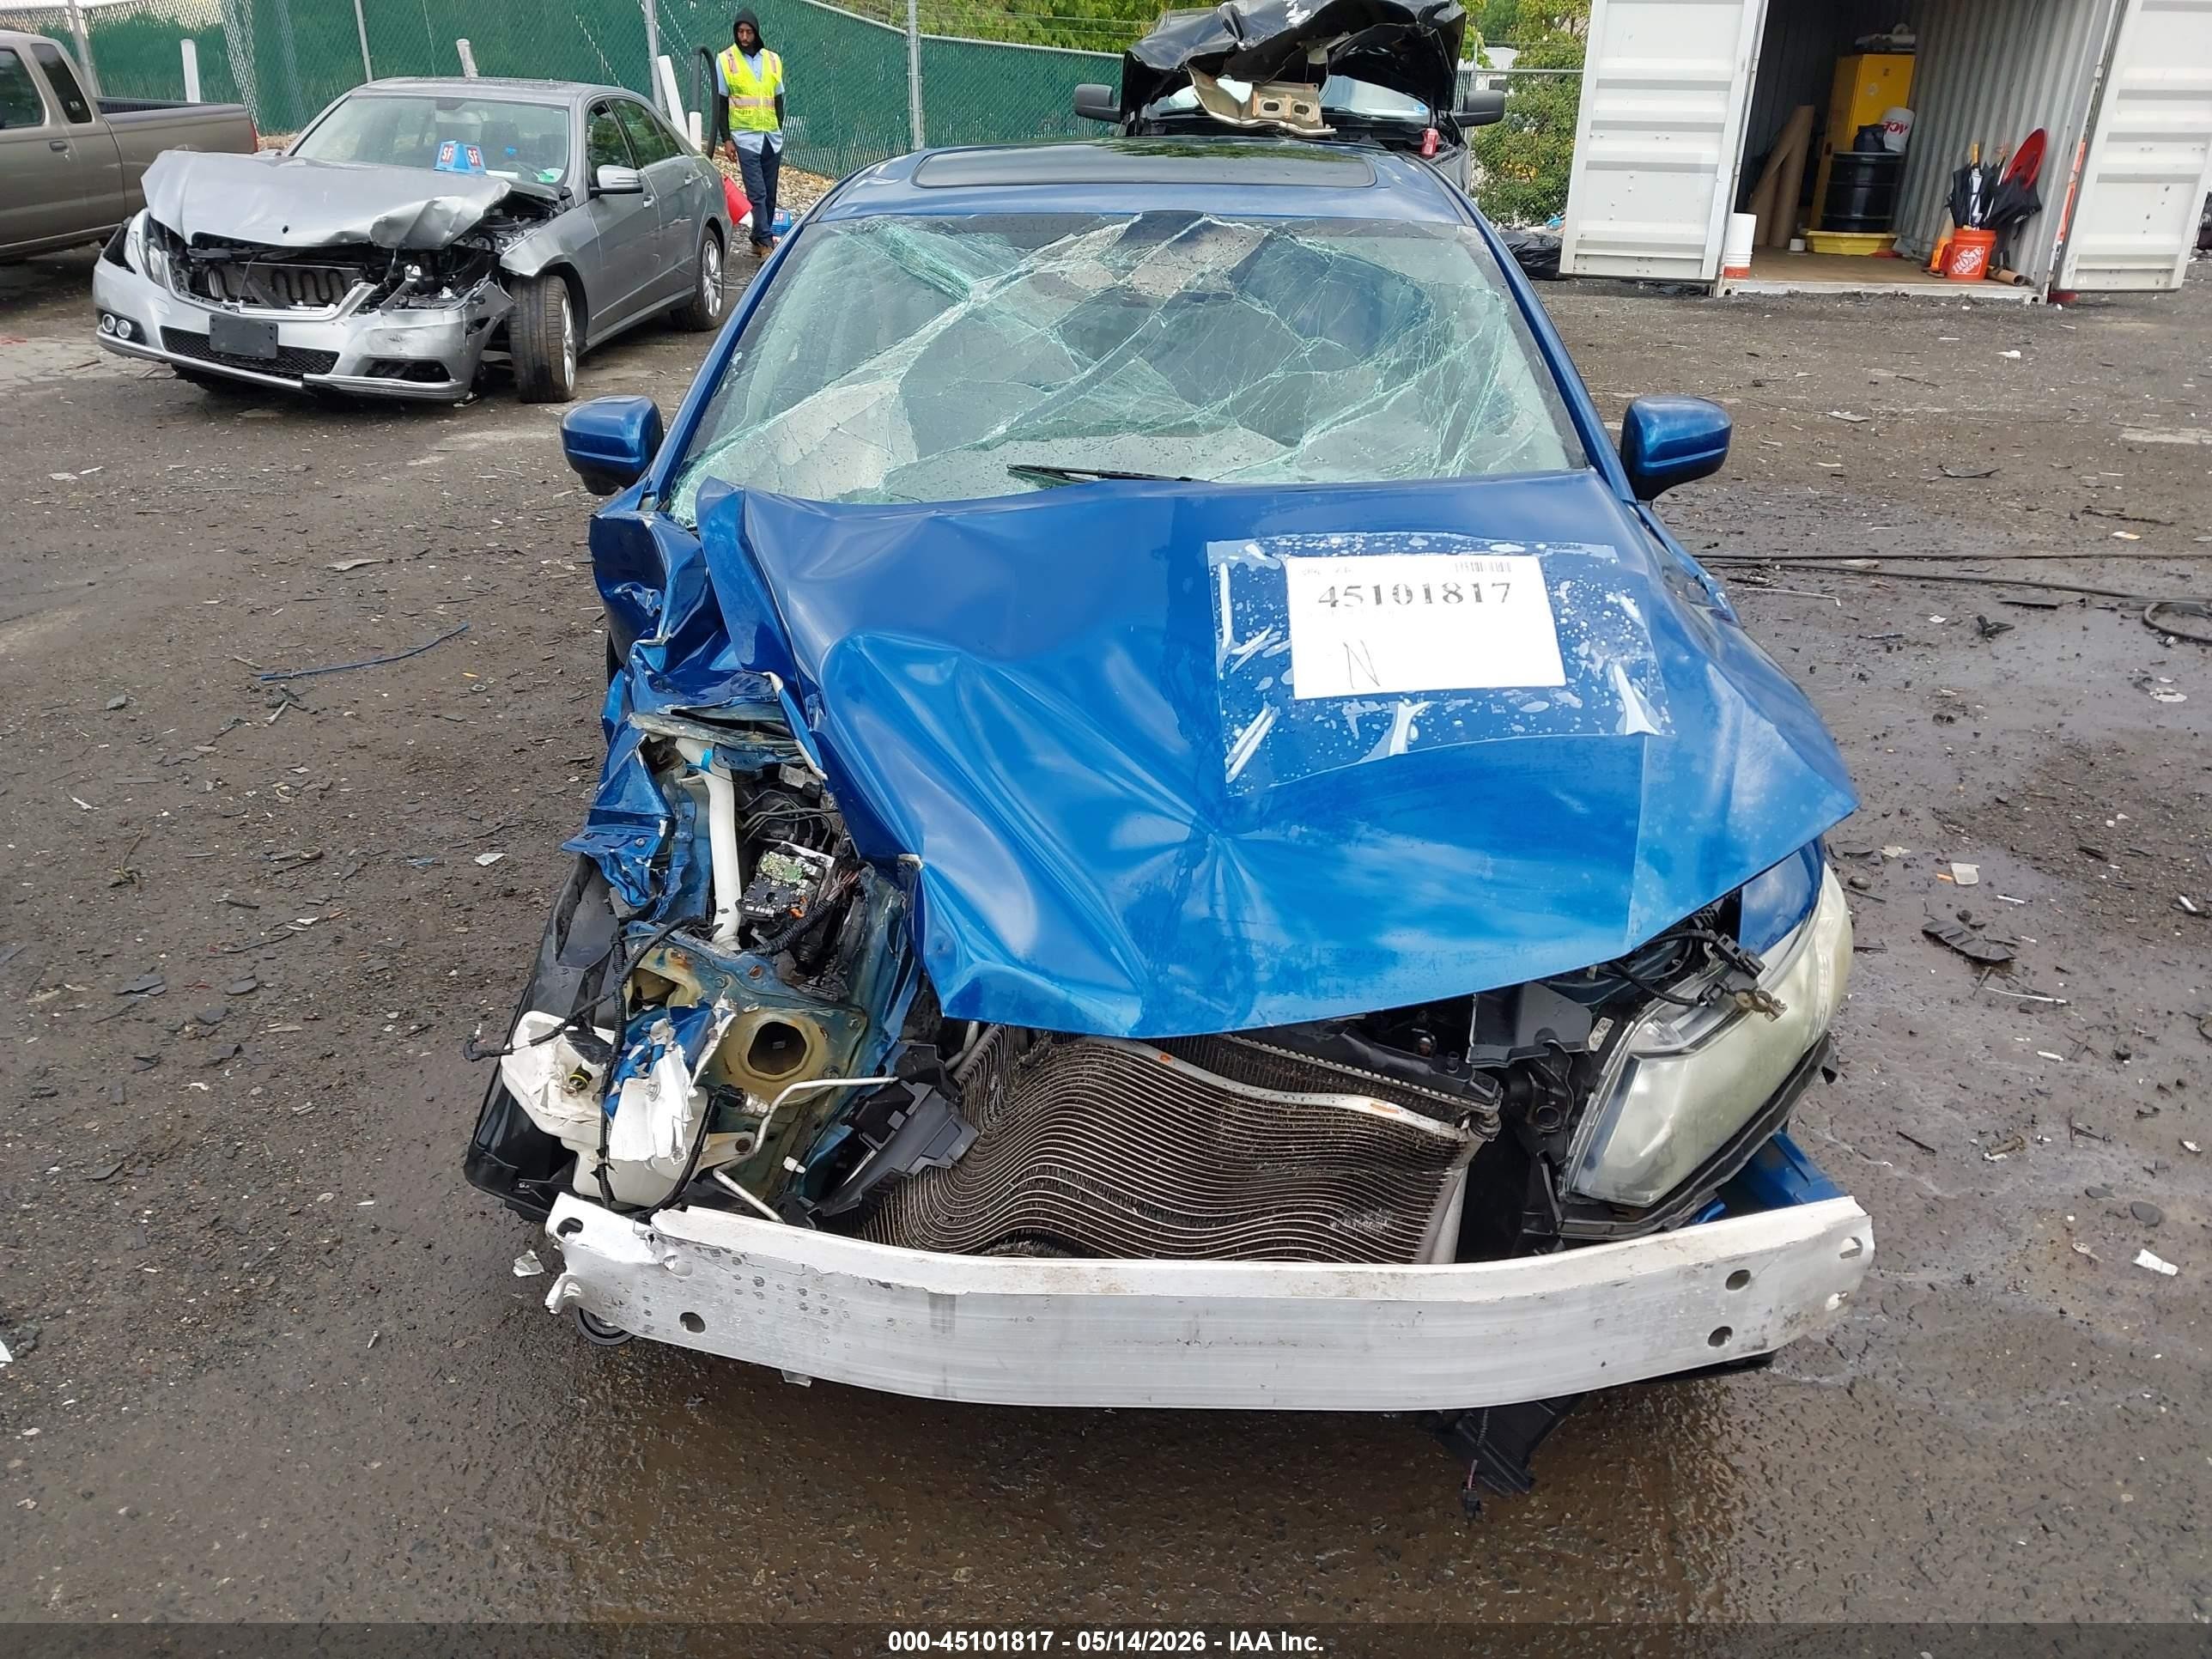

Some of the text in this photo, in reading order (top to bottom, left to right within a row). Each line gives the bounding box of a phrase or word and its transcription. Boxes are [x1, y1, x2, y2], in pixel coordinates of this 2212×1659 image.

[441, 147, 453, 161] SF
[467, 149, 479, 164] SF
[1318, 582, 1511, 608] 45101817
